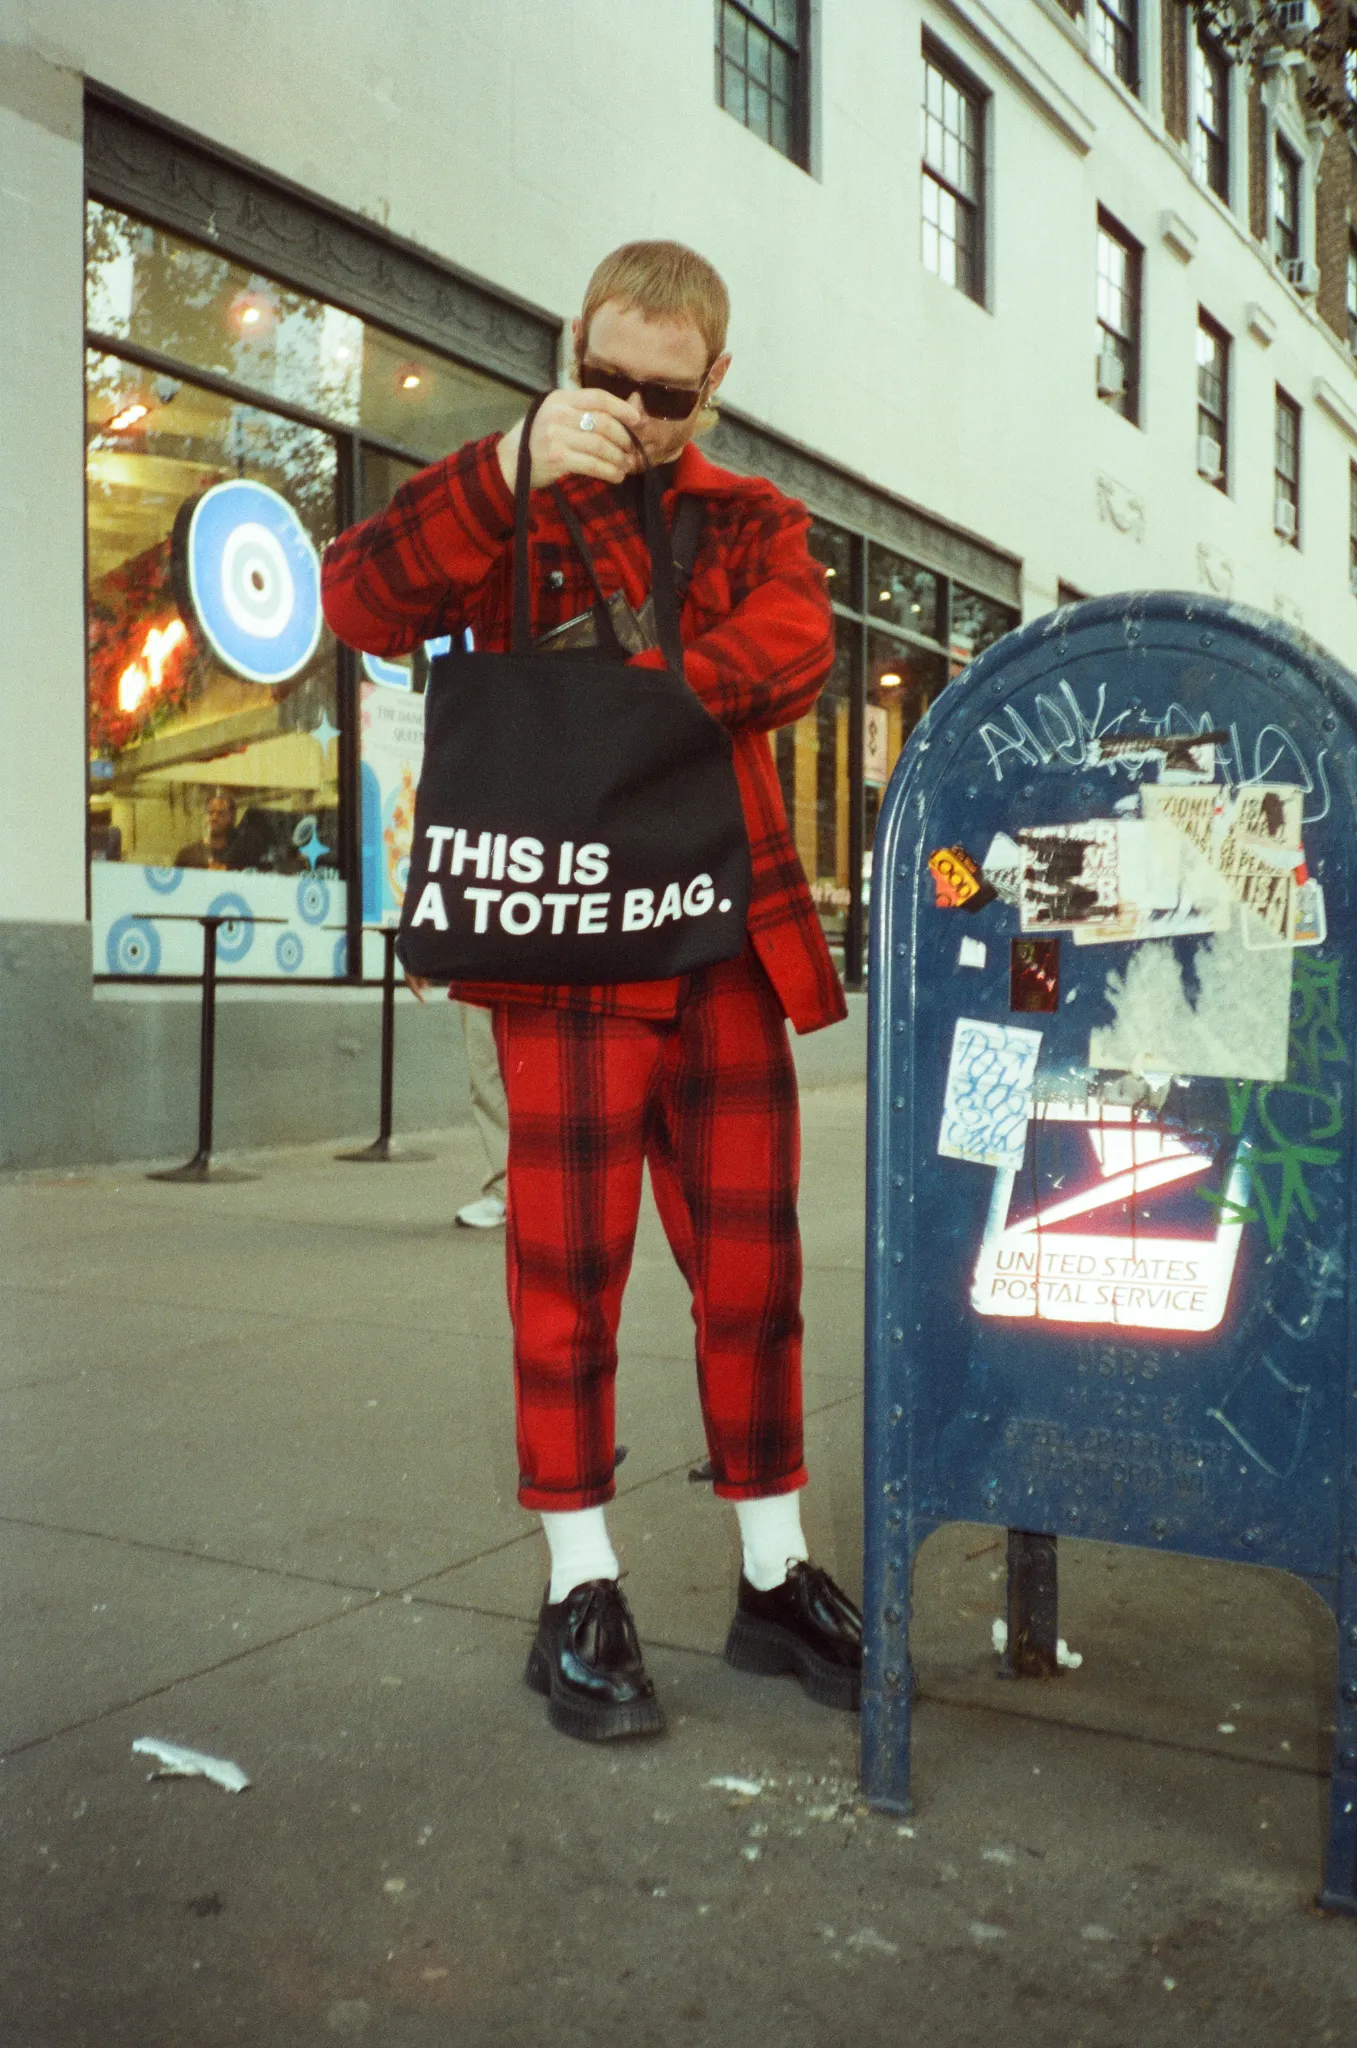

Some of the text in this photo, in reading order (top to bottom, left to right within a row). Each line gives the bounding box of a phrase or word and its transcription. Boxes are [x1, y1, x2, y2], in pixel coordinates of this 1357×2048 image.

[425, 824, 611, 886] THIS IS
[410, 872, 733, 936] A TOTE BAG.
[996, 1250, 1200, 1281] UNTED STATES
[990, 1278, 1210, 1312] POSTAL SERVICE
